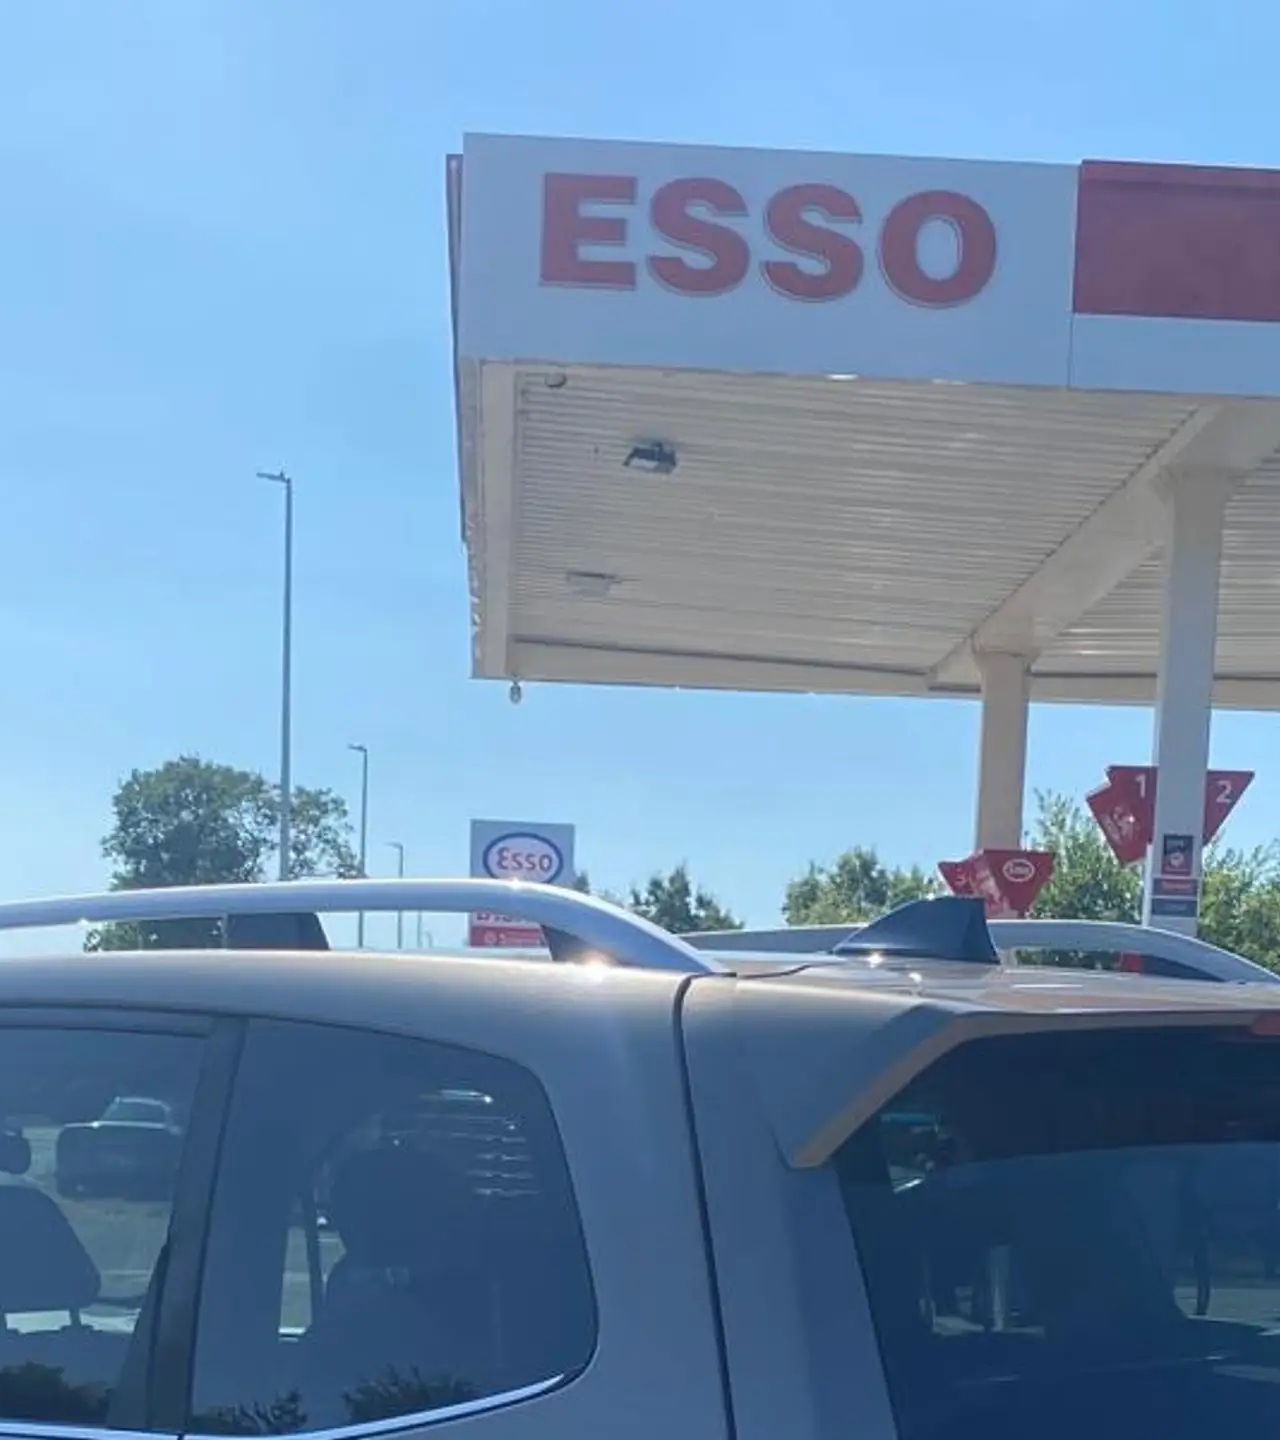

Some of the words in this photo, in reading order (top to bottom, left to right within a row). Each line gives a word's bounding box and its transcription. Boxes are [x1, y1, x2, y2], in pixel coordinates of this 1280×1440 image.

[539, 172, 997, 309] ESSO
[1135, 773, 1147, 799] 1
[1216, 780, 1233, 804] 2
